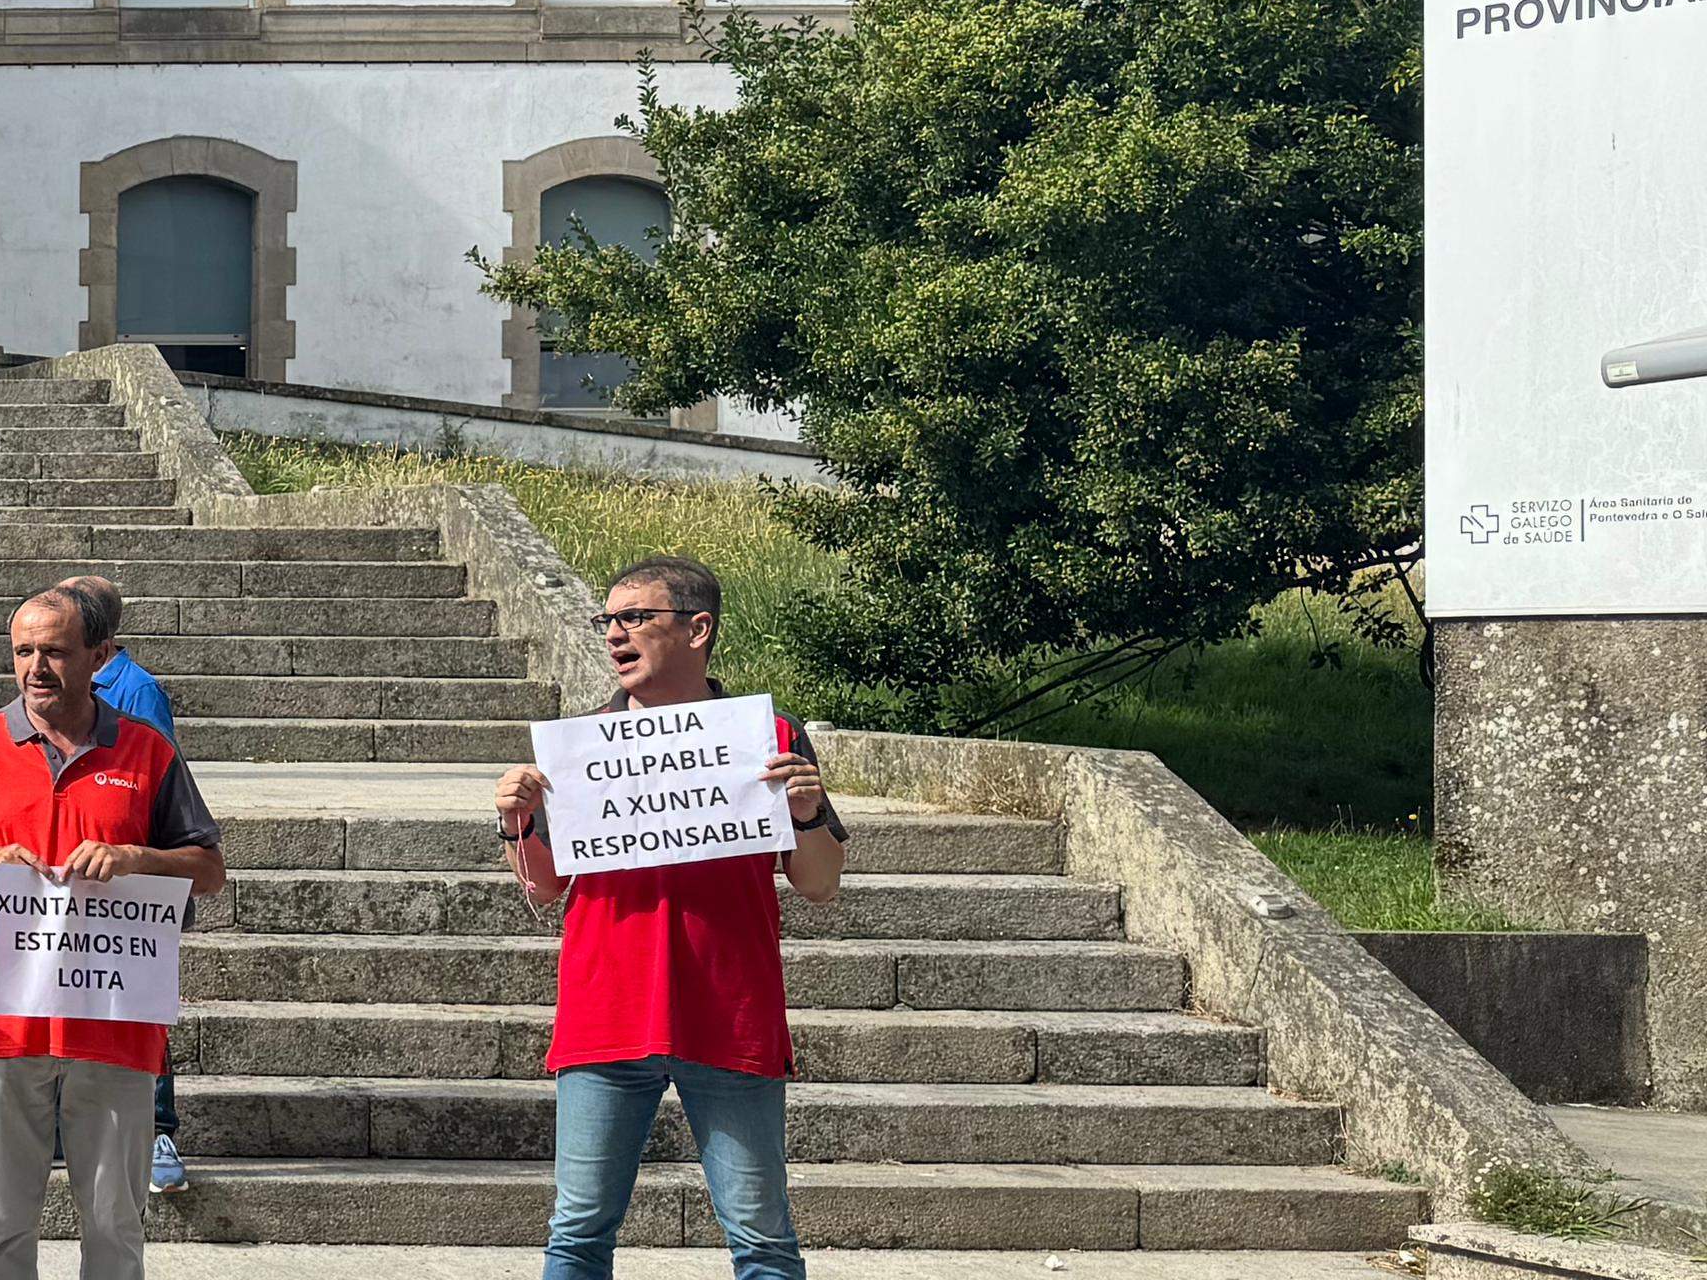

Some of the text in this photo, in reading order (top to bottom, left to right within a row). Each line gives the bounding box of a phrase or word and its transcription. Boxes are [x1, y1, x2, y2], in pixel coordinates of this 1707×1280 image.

[1511, 499, 1573, 514] SERVIZO
[1620, 496, 1674, 508] Sanitaria
[1672, 509, 1683, 520] O
[1510, 515, 1573, 530] GALEGO
[1524, 527, 1573, 544] SAÚDE
[598, 711, 704, 743] VEOLIA
[586, 745, 730, 782] CULPABLE
[601, 785, 729, 820] A XUNTA
[571, 818, 773, 860] RESPONSABLE
[85, 898, 177, 925] ESCOITA
[14, 931, 157, 958] ESTAMOS EN
[58, 967, 125, 991] LOITA
